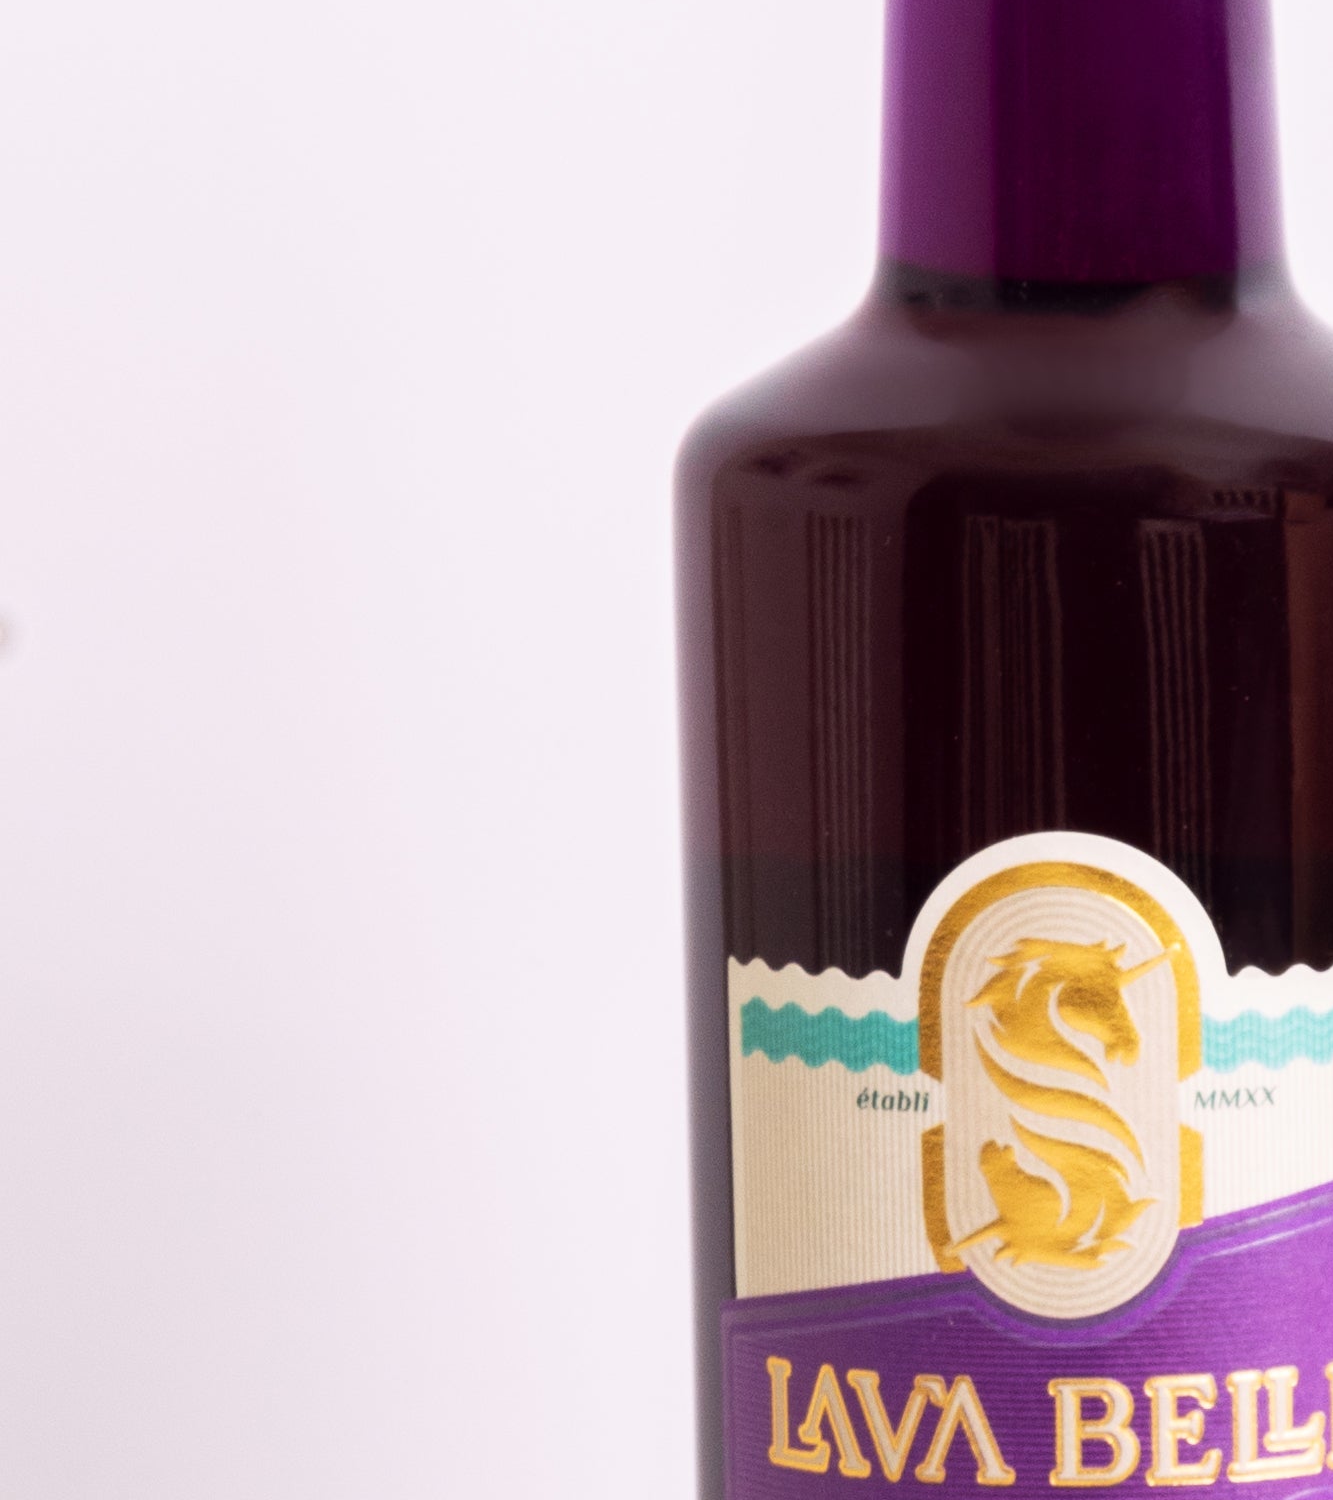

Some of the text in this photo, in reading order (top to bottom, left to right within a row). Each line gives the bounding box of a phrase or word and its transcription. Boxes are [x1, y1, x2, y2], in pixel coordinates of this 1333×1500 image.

[856, 1087, 930, 1113] établi
[1193, 1085, 1278, 1111] MMXX
[767, 1355, 1016, 1486] LAVA
